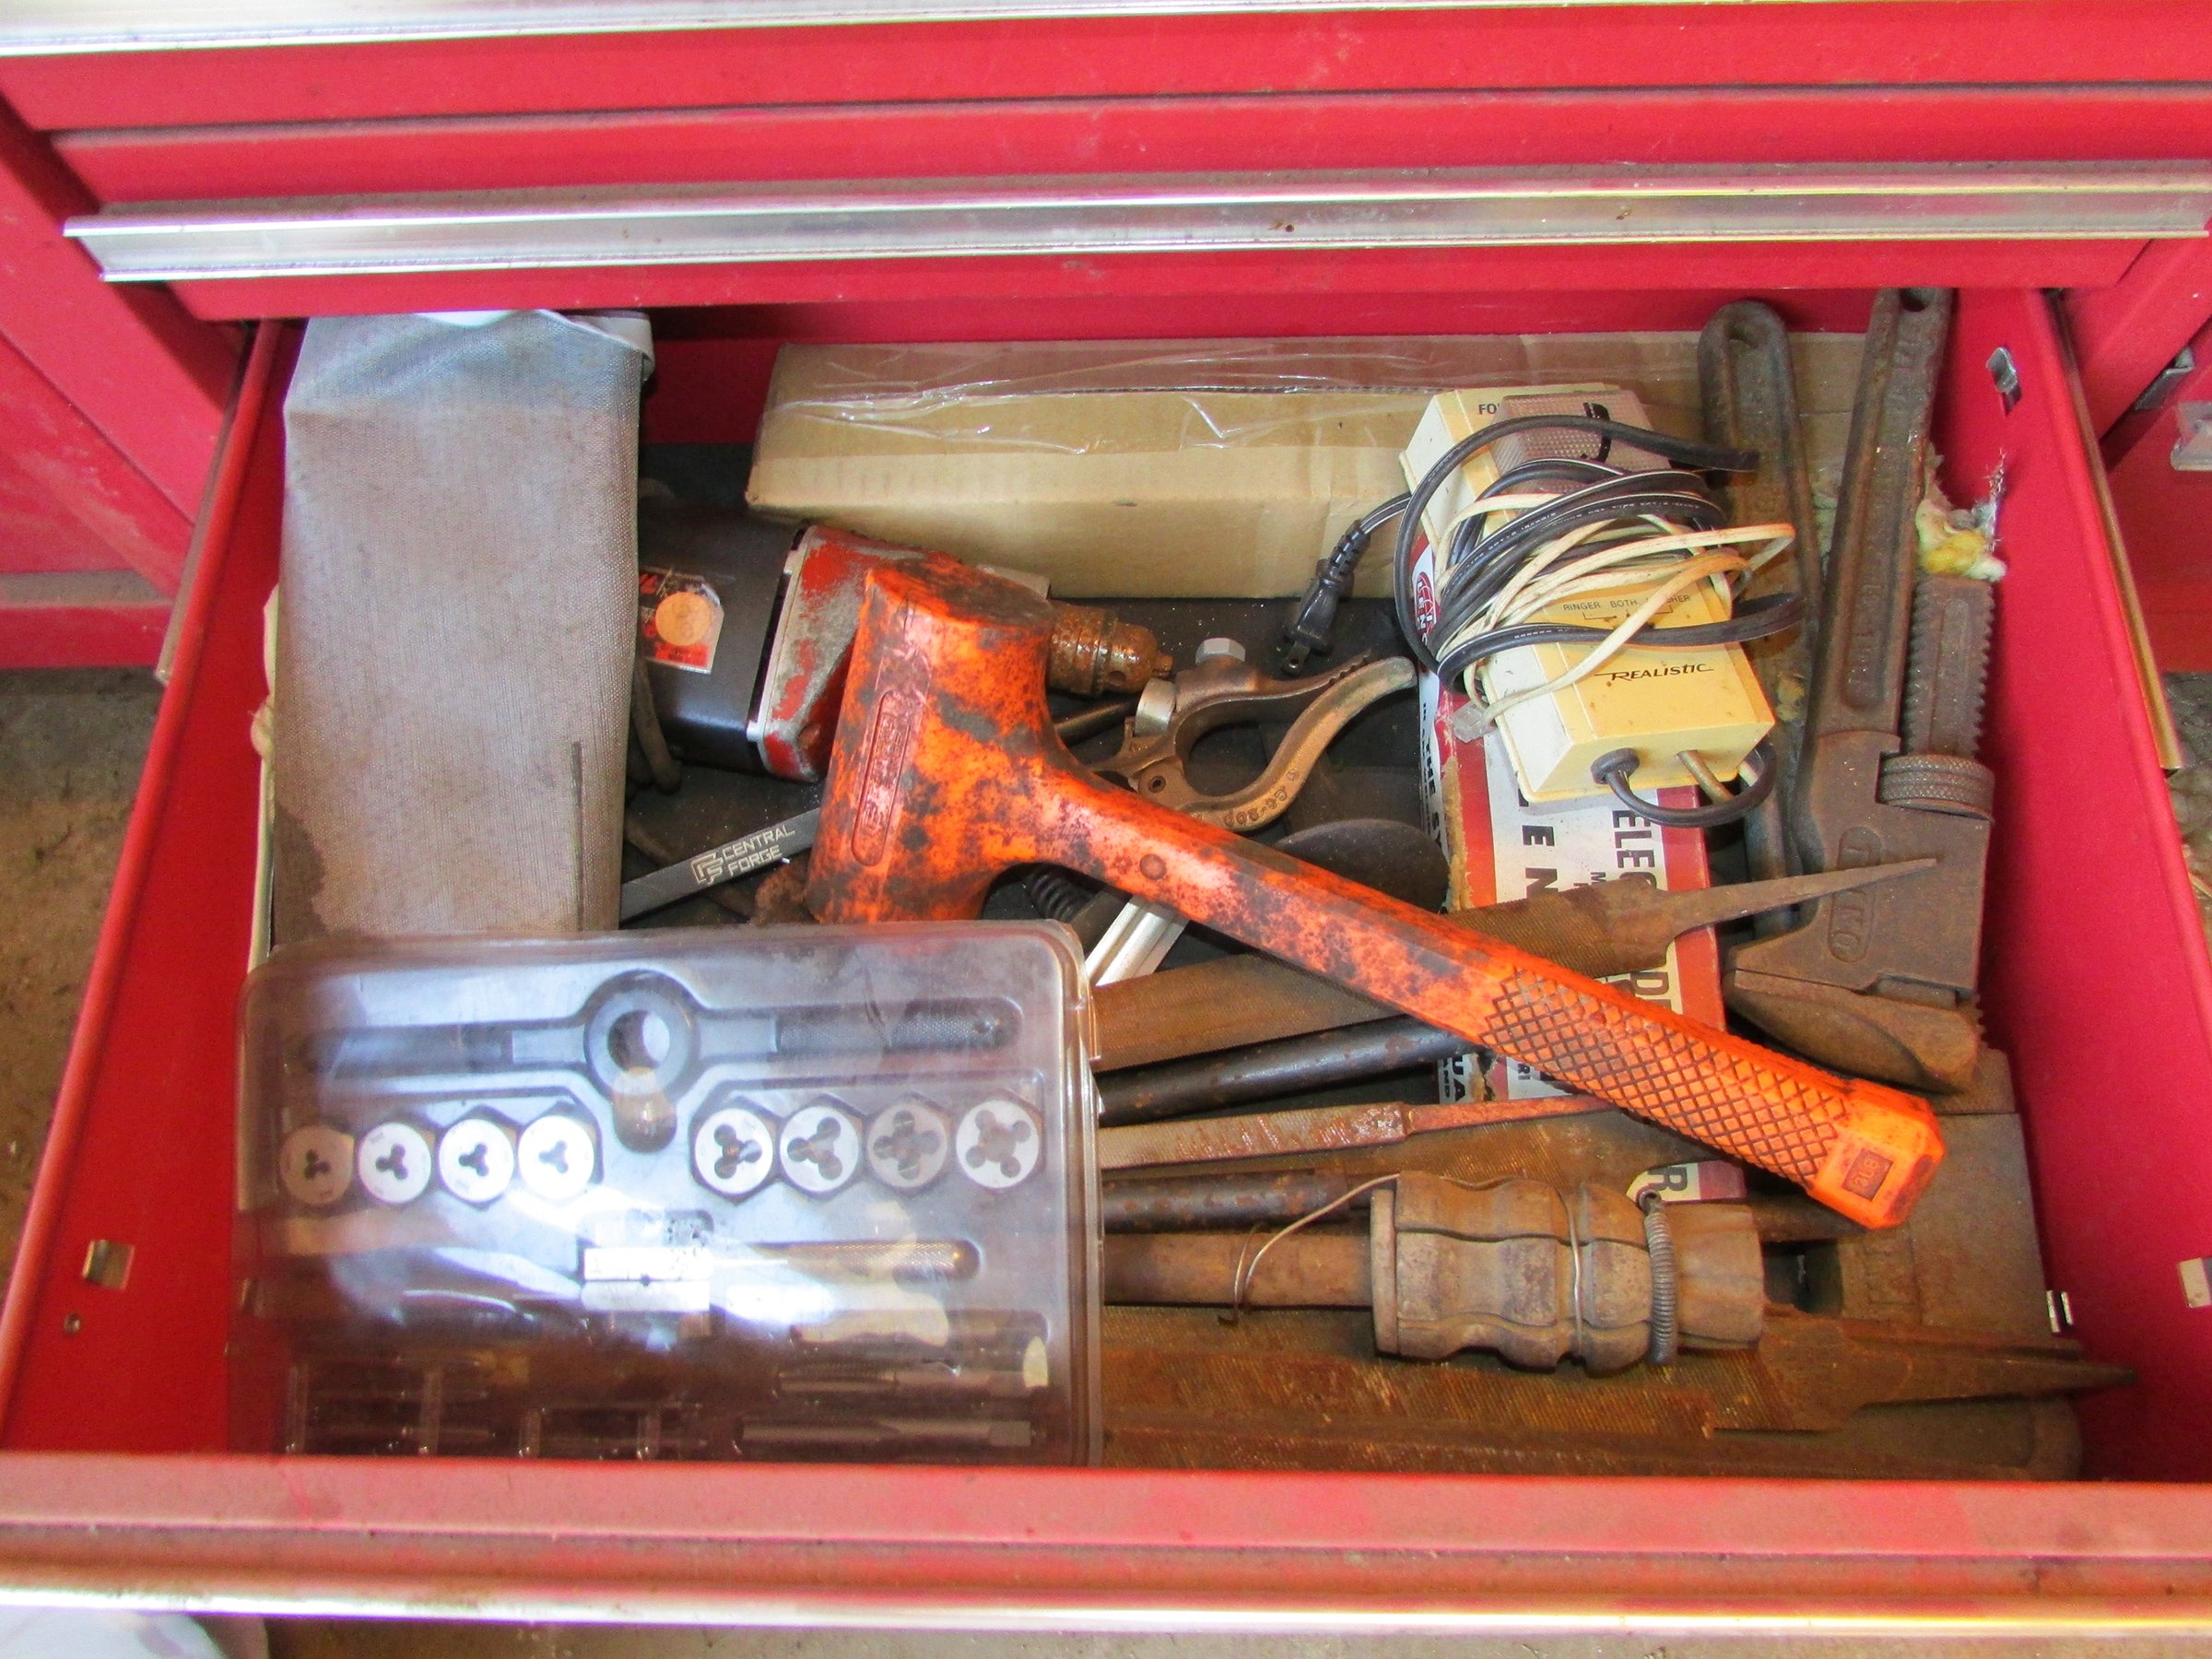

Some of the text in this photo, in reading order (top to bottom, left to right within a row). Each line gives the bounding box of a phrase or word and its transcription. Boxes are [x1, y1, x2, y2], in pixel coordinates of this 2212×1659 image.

[1477, 403, 1500, 415] FO
[1562, 601, 1601, 611] RINGER
[1609, 598, 1637, 609] BOTH
[722, 825, 795, 861] CENTRAL
[728, 844, 782, 877] FORGE
